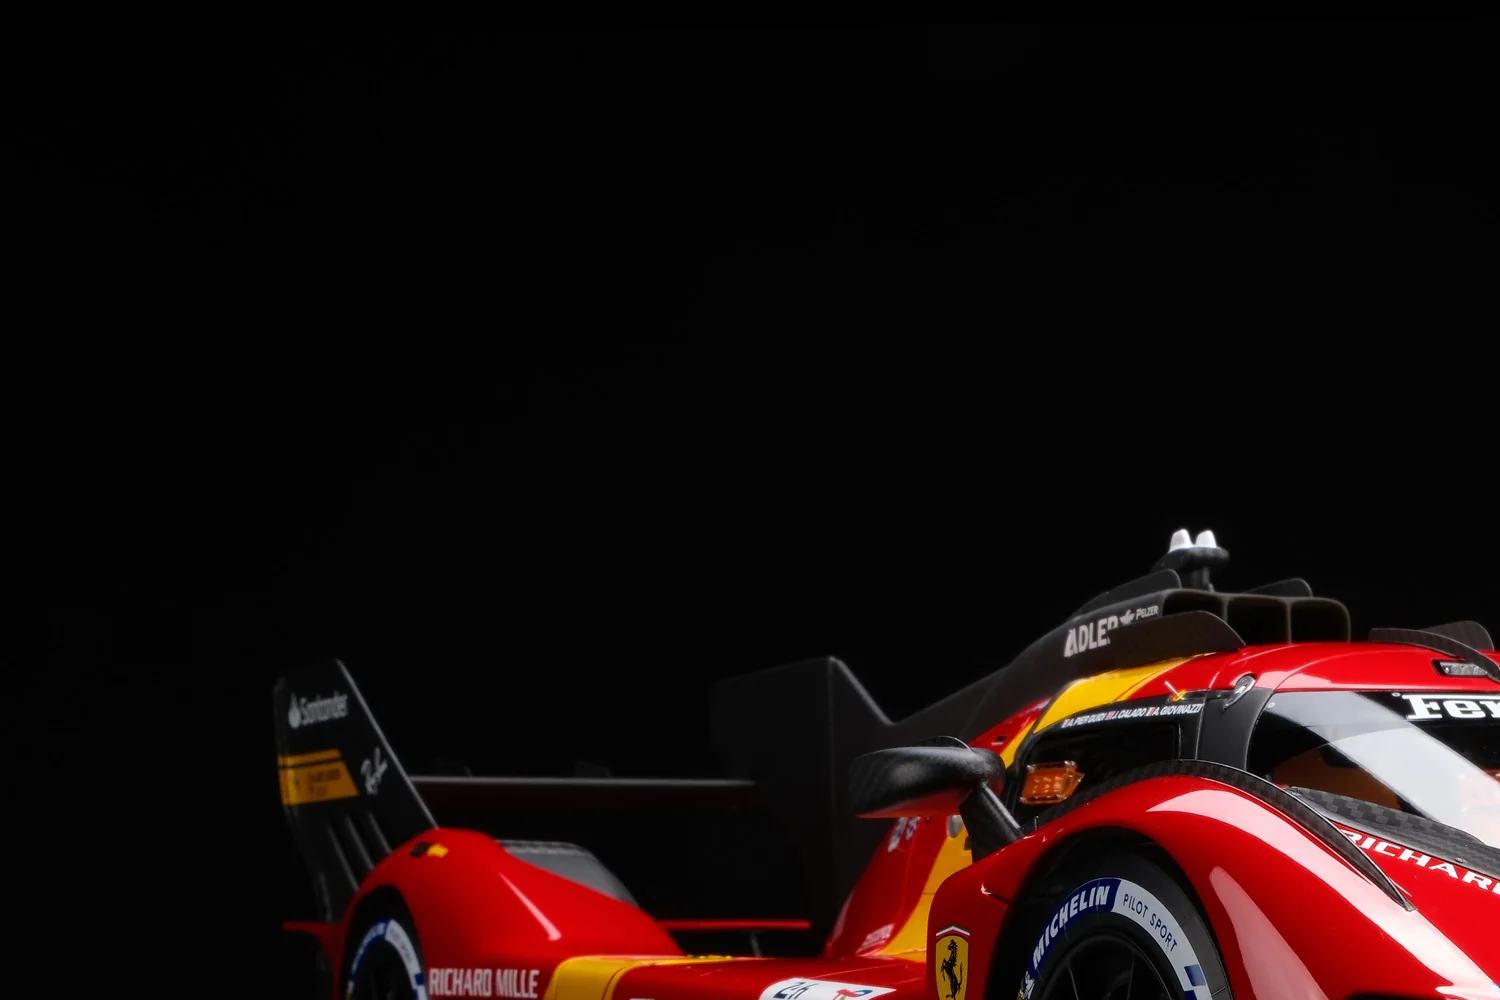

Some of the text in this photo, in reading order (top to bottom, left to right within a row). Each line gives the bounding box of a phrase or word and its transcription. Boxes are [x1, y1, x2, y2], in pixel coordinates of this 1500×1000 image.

[1033, 885, 1178, 971] MICHELIN PILOT SPORT
[428, 967, 541, 999] RICHARD MILLE
